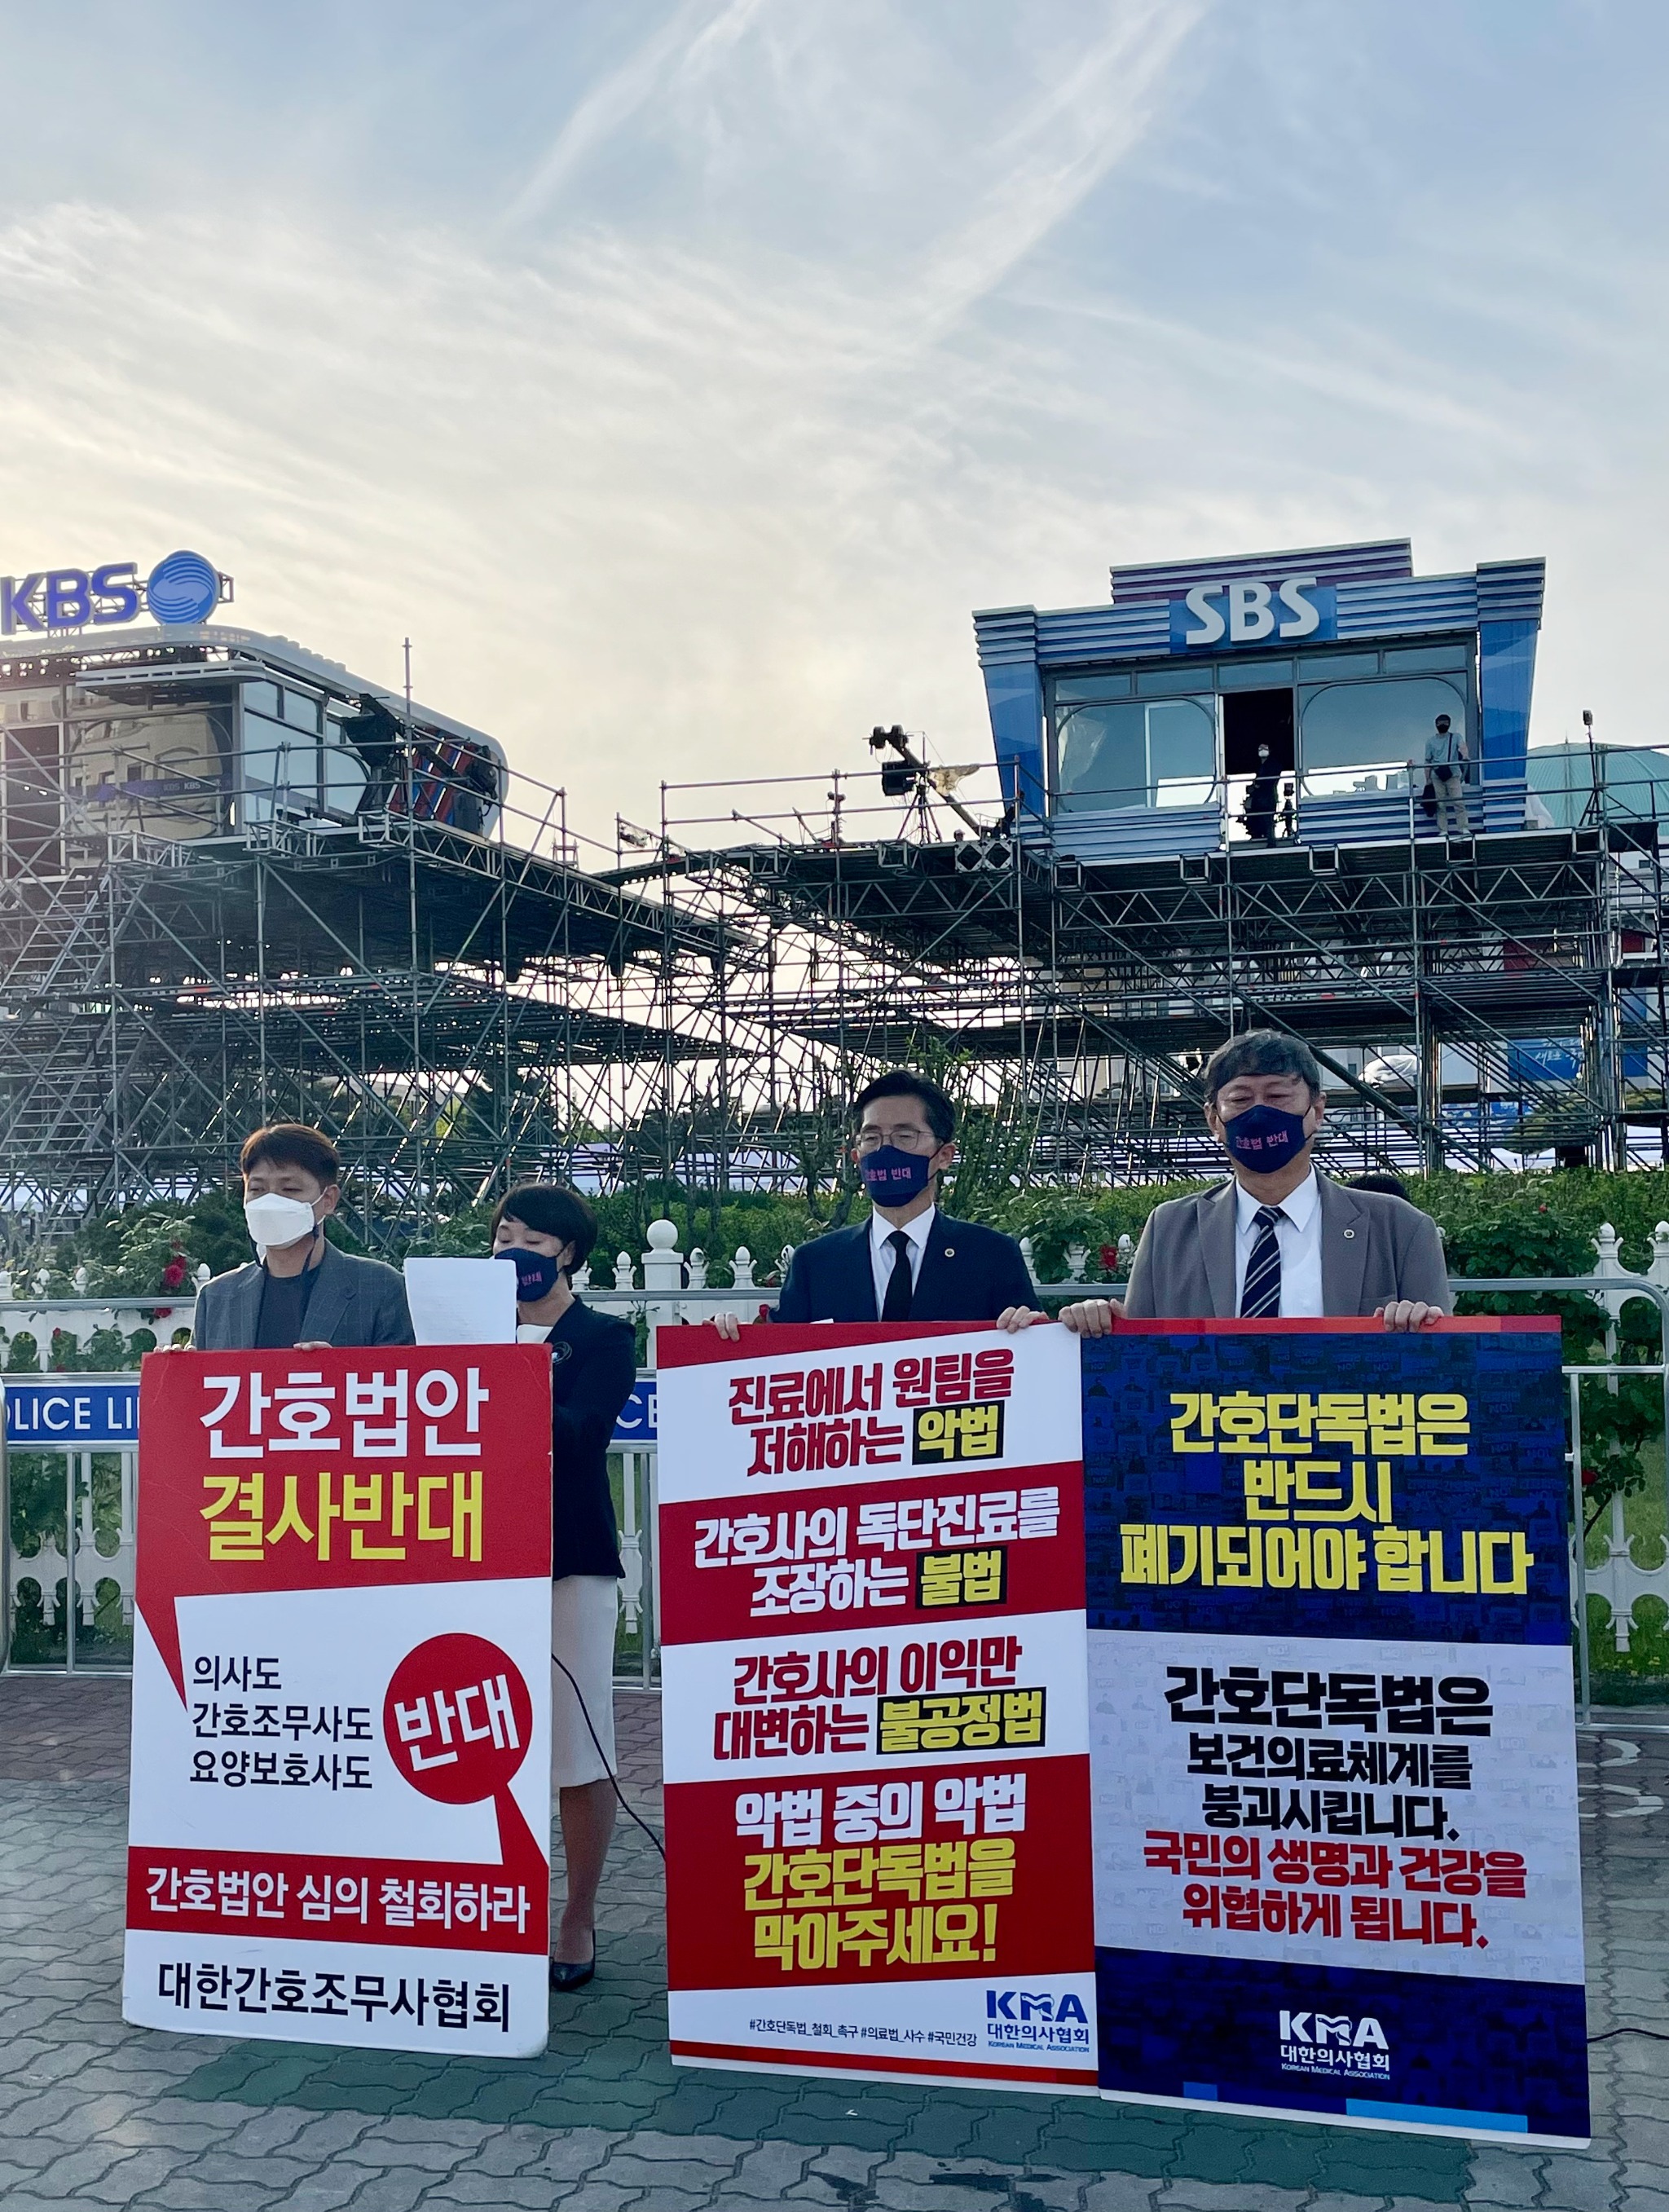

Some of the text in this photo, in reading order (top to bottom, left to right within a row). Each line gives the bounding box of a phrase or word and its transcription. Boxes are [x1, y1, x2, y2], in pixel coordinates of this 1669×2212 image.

[0, 562, 140, 636] KBS
[1186, 577, 1319, 645] SBS
[1266, 1130, 1288, 1148] 반대
[892, 1167, 911, 1180] 반대
[200, 1367, 489, 1459] 간호법안
[729, 1350, 1014, 1425] 진료에서 원팀을
[746, 1405, 998, 1477] 저해하는 악법
[1170, 1391, 1469, 1456] 간호단독법은
[200, 1470, 482, 1562] 결사반대
[1244, 1460, 1392, 1522] 반드시
[694, 1487, 1059, 1569] 간호사의 독단진료를
[1120, 1524, 1535, 1594] 폐기되어야 합니다
[750, 1550, 1002, 1617] 조장하는 불법
[193, 1655, 282, 1692] 의사도
[734, 1636, 1022, 1706] 간호사의 이익만
[1164, 1666, 1494, 1738] 간호단독법은
[192, 1702, 373, 1743] 간호조무사도
[394, 1674, 520, 1772] 반대
[714, 1690, 1042, 1760] 대변하는 불공정법
[189, 1751, 372, 1791] 요양보호사도
[1187, 1732, 1473, 1790] 보건의료체계를
[735, 1773, 1027, 1848] 악법 중의 악법
[1201, 1783, 1460, 1841] 붕괴시킵니다.
[744, 1838, 1016, 1911] 간호단독법을
[1143, 1831, 1527, 1898] 국민의 생명과 건강을
[146, 1867, 531, 1934] 간호법안 심의 철회하라
[1183, 1884, 1490, 1949] 위협하게 됩니다.
[754, 1904, 998, 1971] 막아주세요!
[158, 1963, 510, 2032] 대한간호조무사협회
[986, 1989, 1089, 2024] KMA
[1279, 2010, 1389, 2050] KMA
[861, 2027, 925, 2043] #의료법_사수
[927, 2031, 977, 2047] #국민건강
[987, 2023, 1090, 2045] 대한의사협회
[1280, 2044, 1390, 2072] 대한의사협회
